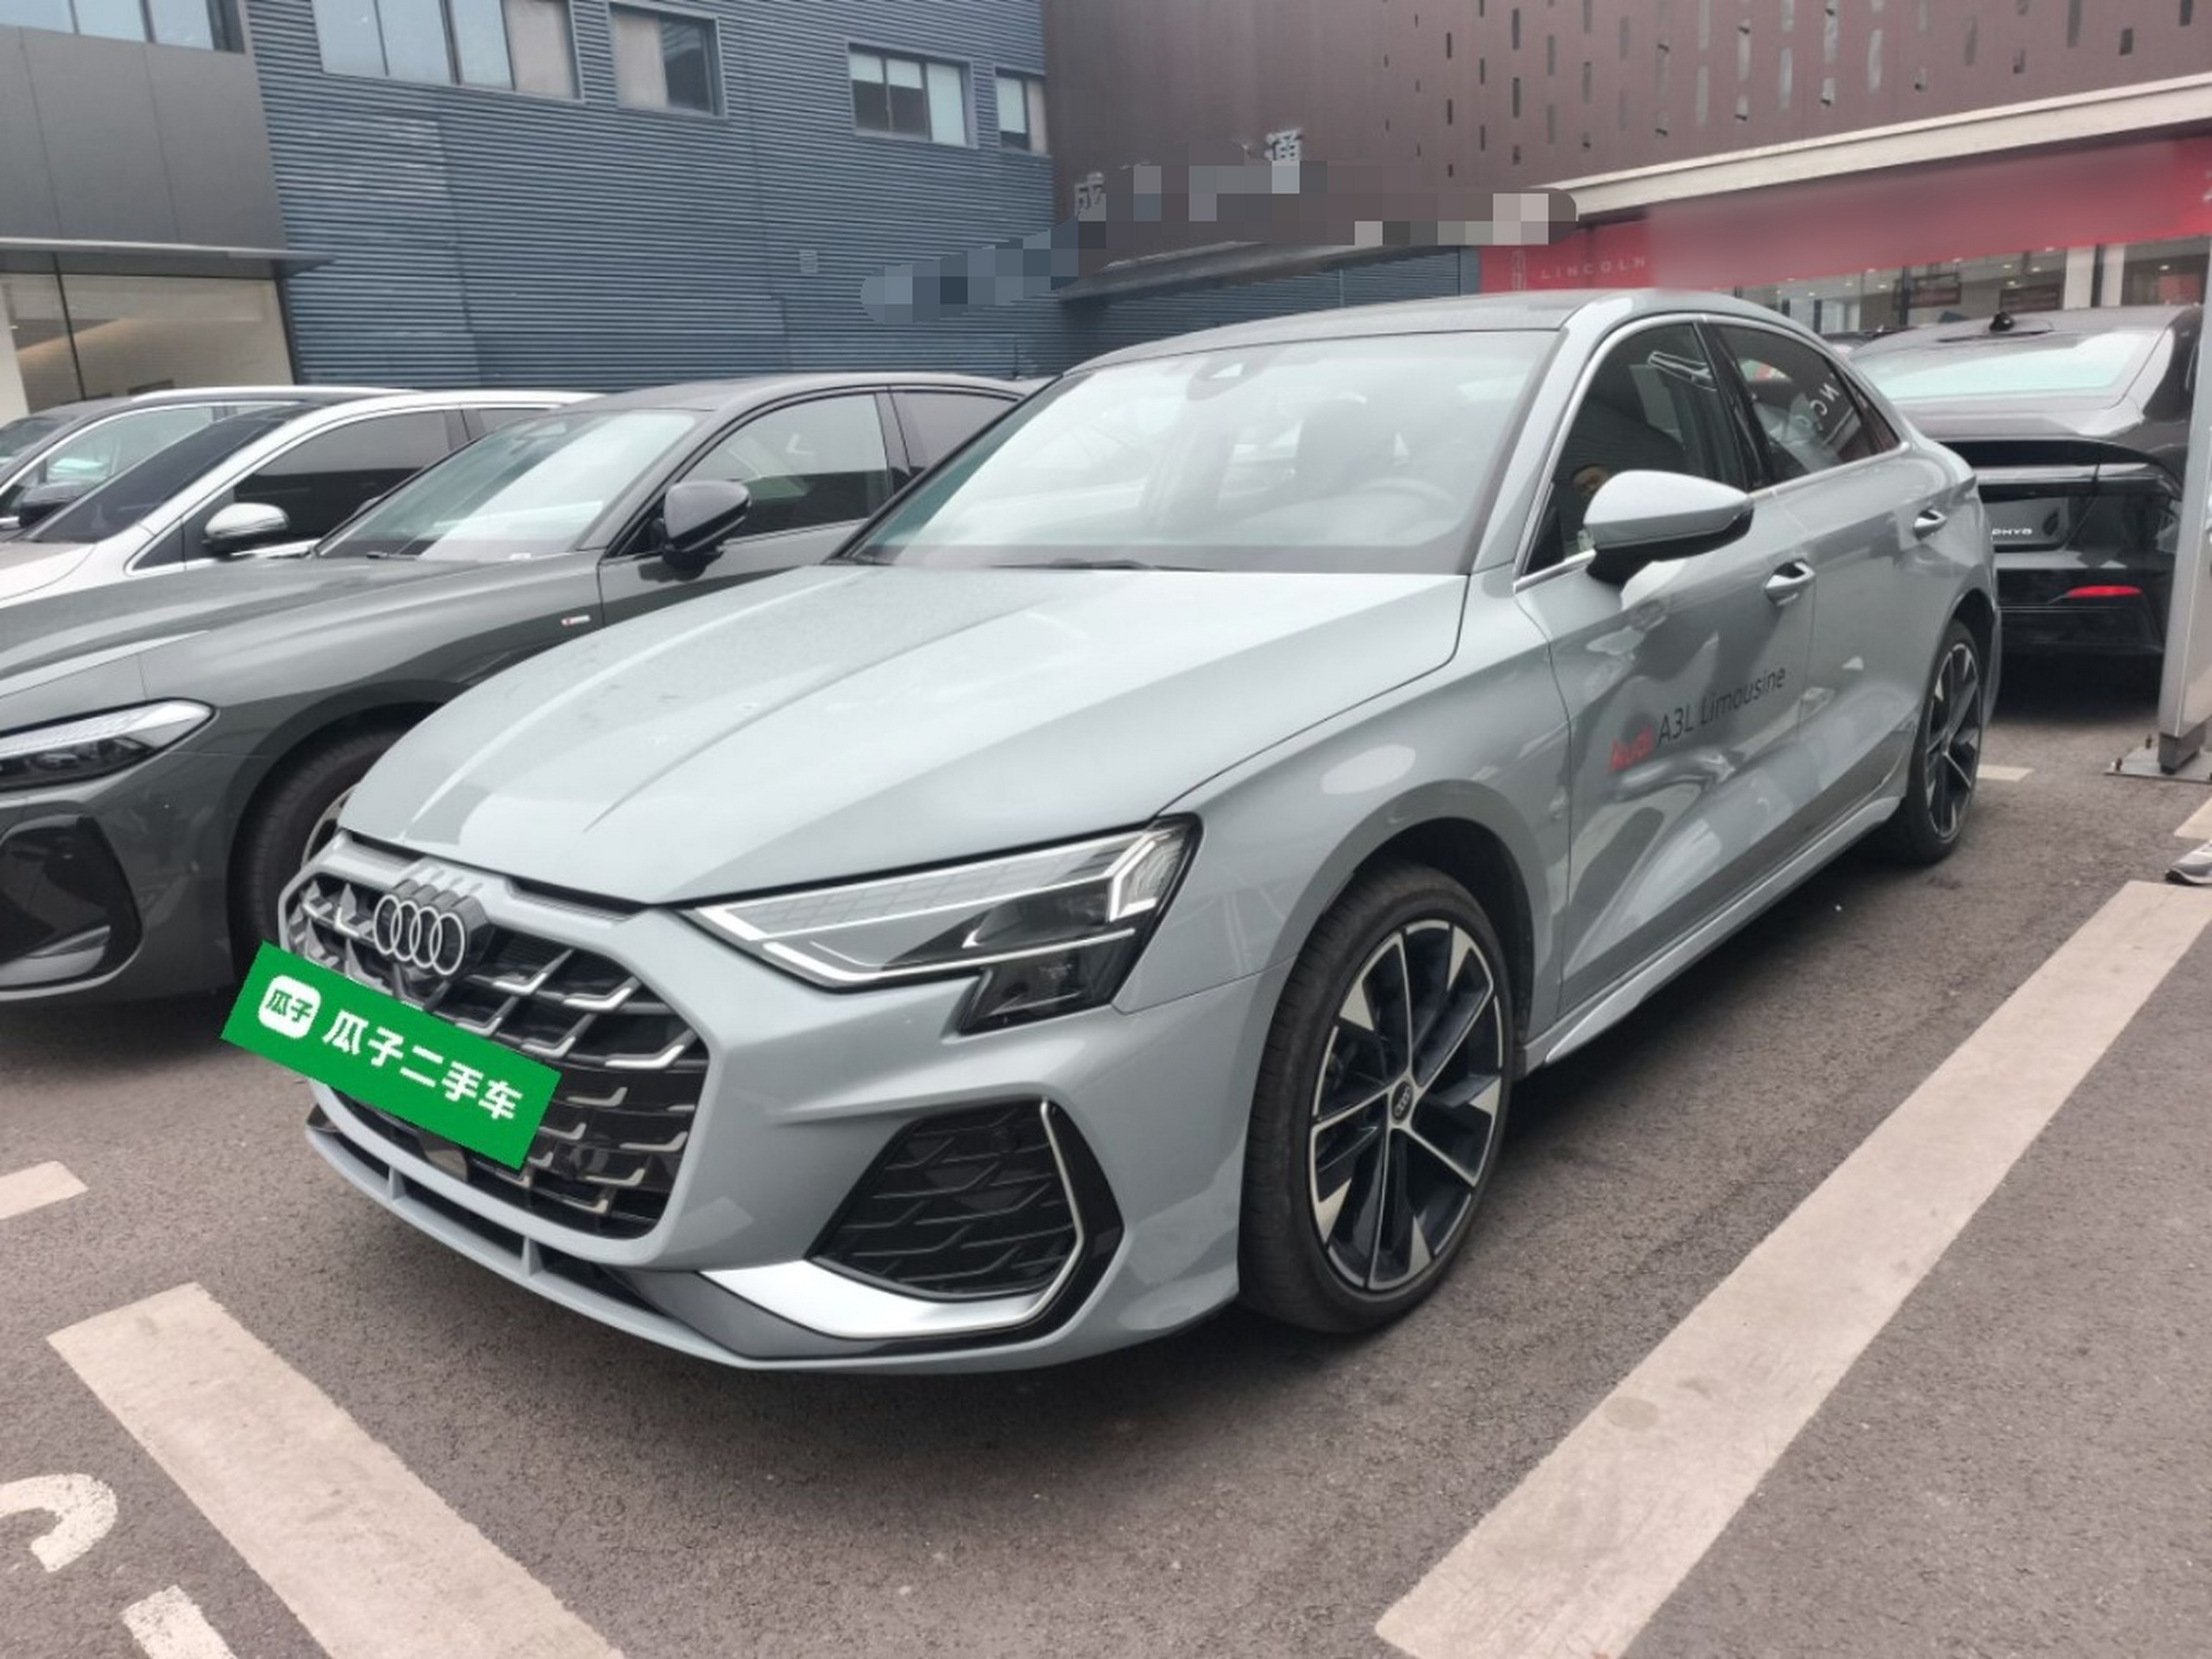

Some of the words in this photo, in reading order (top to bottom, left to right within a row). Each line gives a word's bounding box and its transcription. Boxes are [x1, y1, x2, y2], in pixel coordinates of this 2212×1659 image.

[1540, 257, 1646, 279] LINCOLN
[1657, 705, 1694, 747] A3L
[1699, 668, 1786, 727] Limousine
